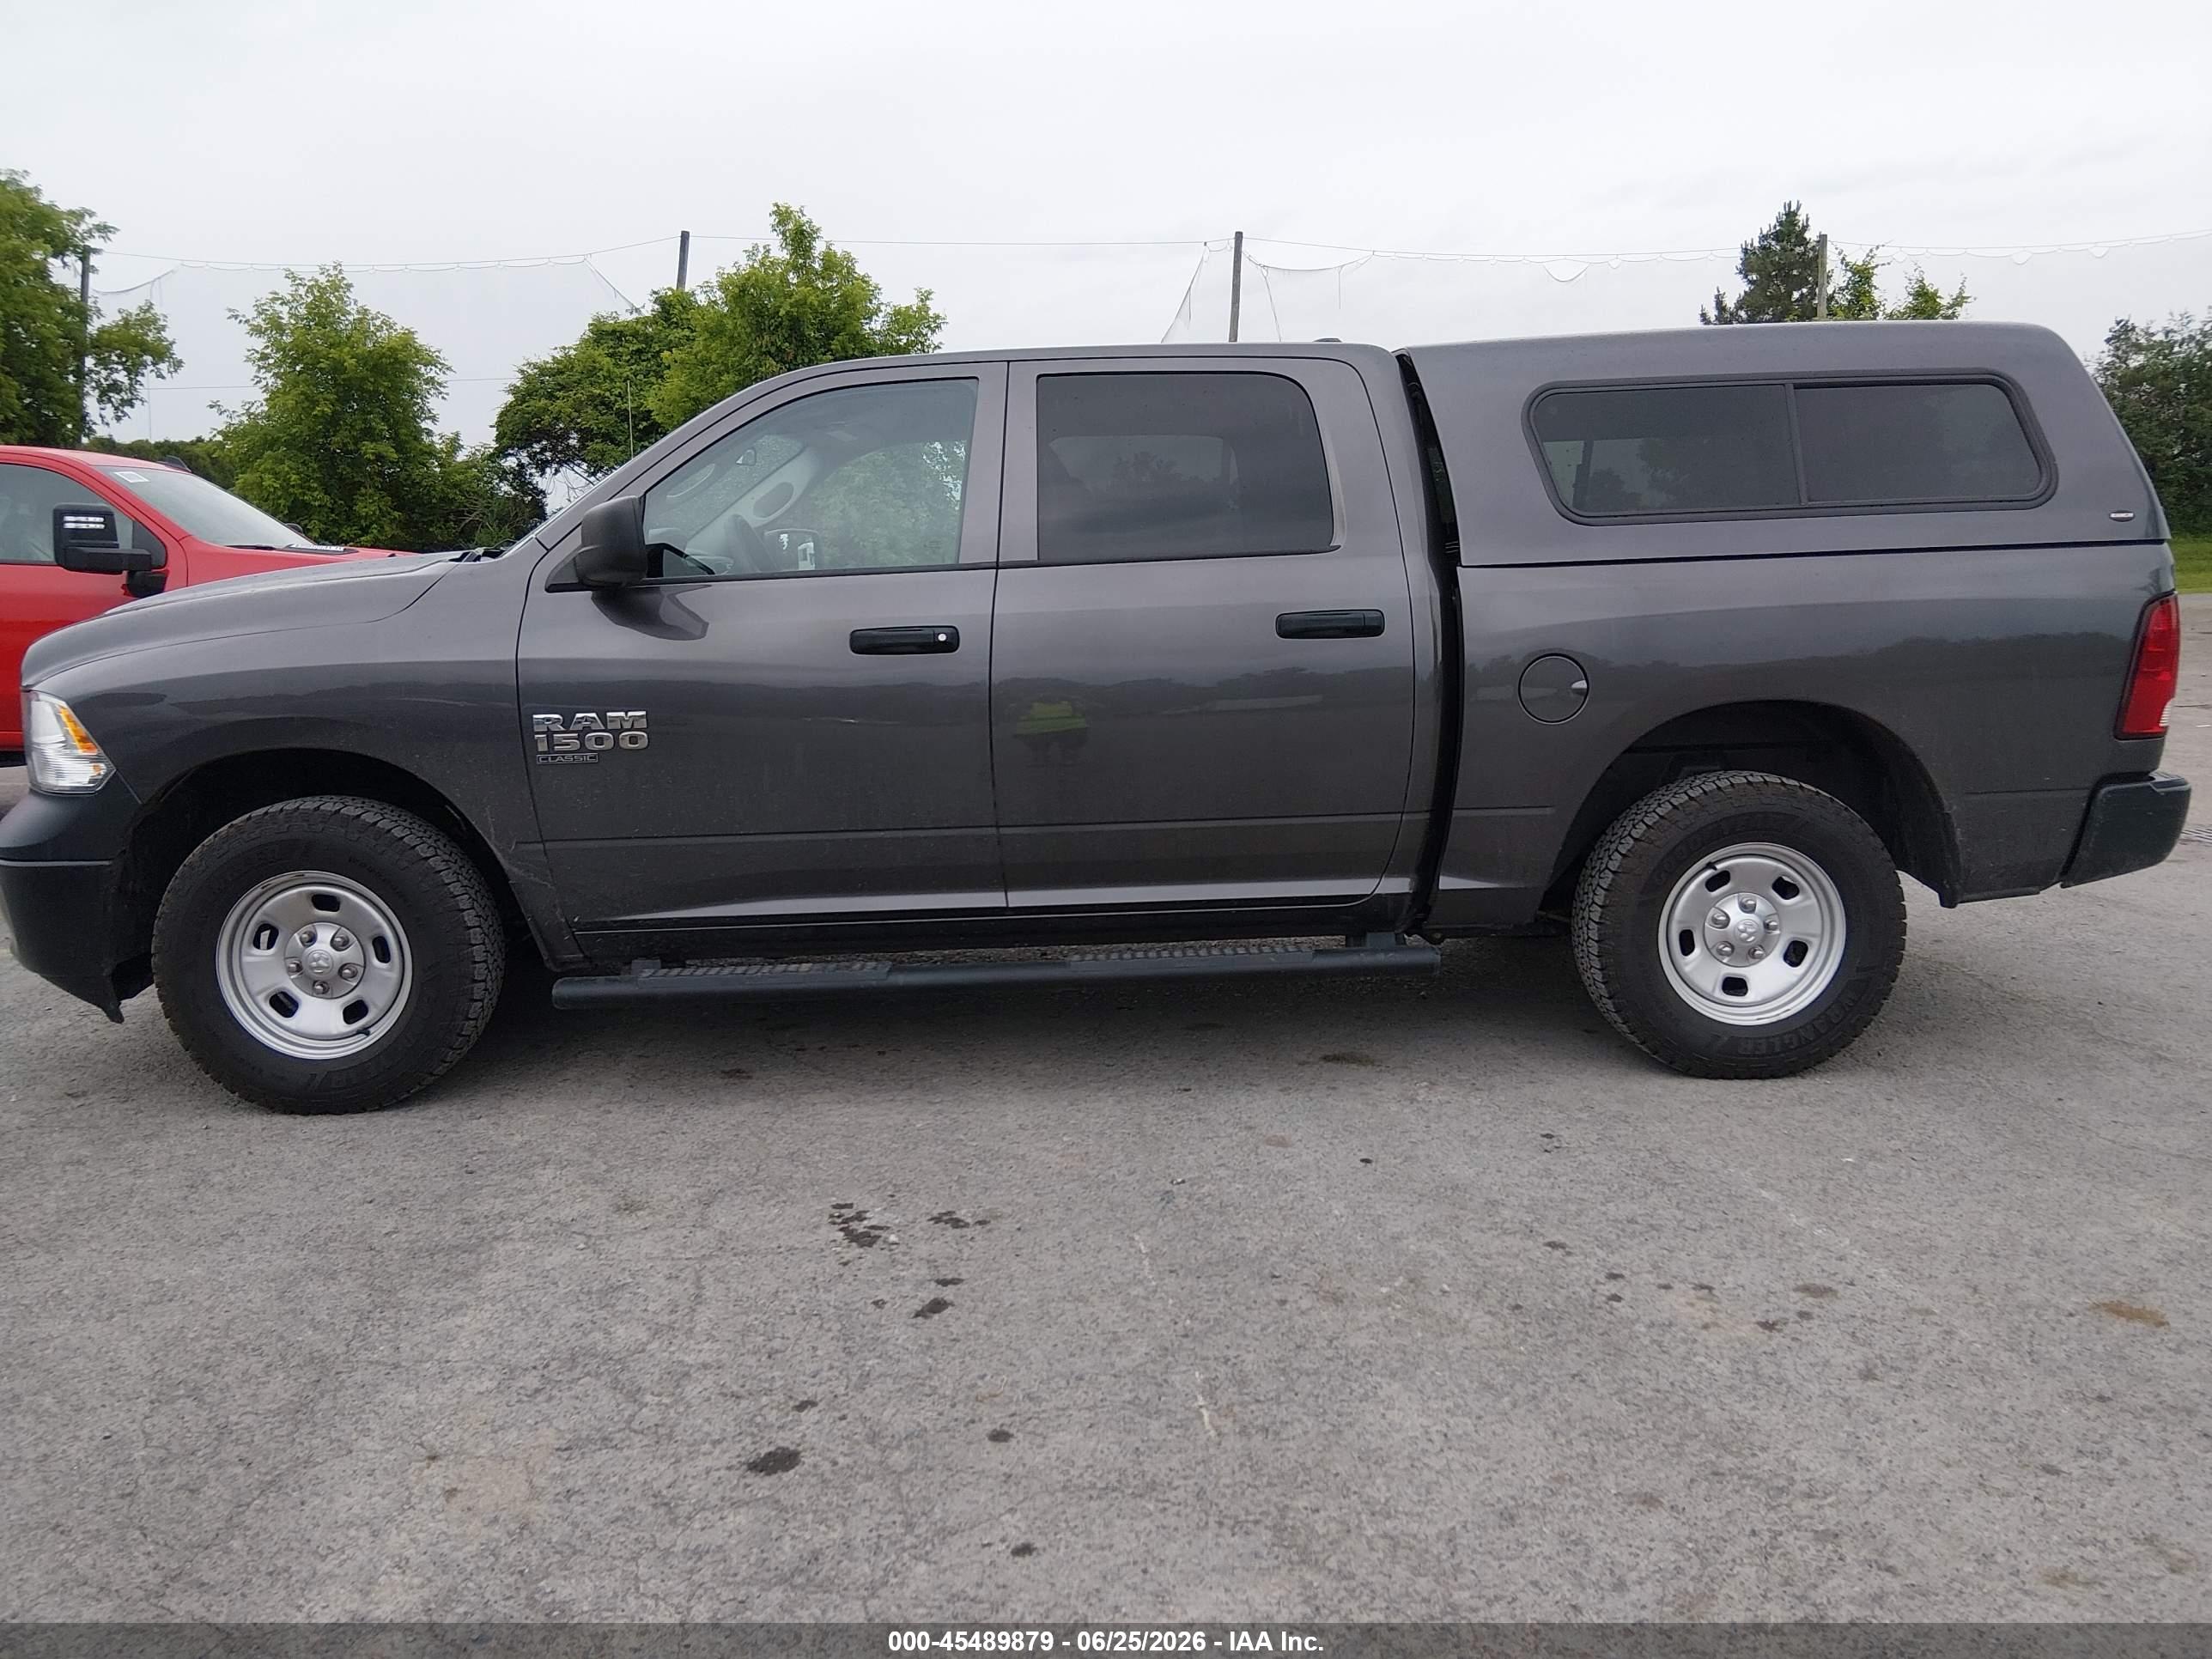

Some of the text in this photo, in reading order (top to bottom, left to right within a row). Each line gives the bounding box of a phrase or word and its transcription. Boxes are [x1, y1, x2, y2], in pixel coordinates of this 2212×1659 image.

[532, 711, 647, 732] RAM
[534, 731, 649, 752] 1500
[538, 754, 597, 763] CLASSIC
